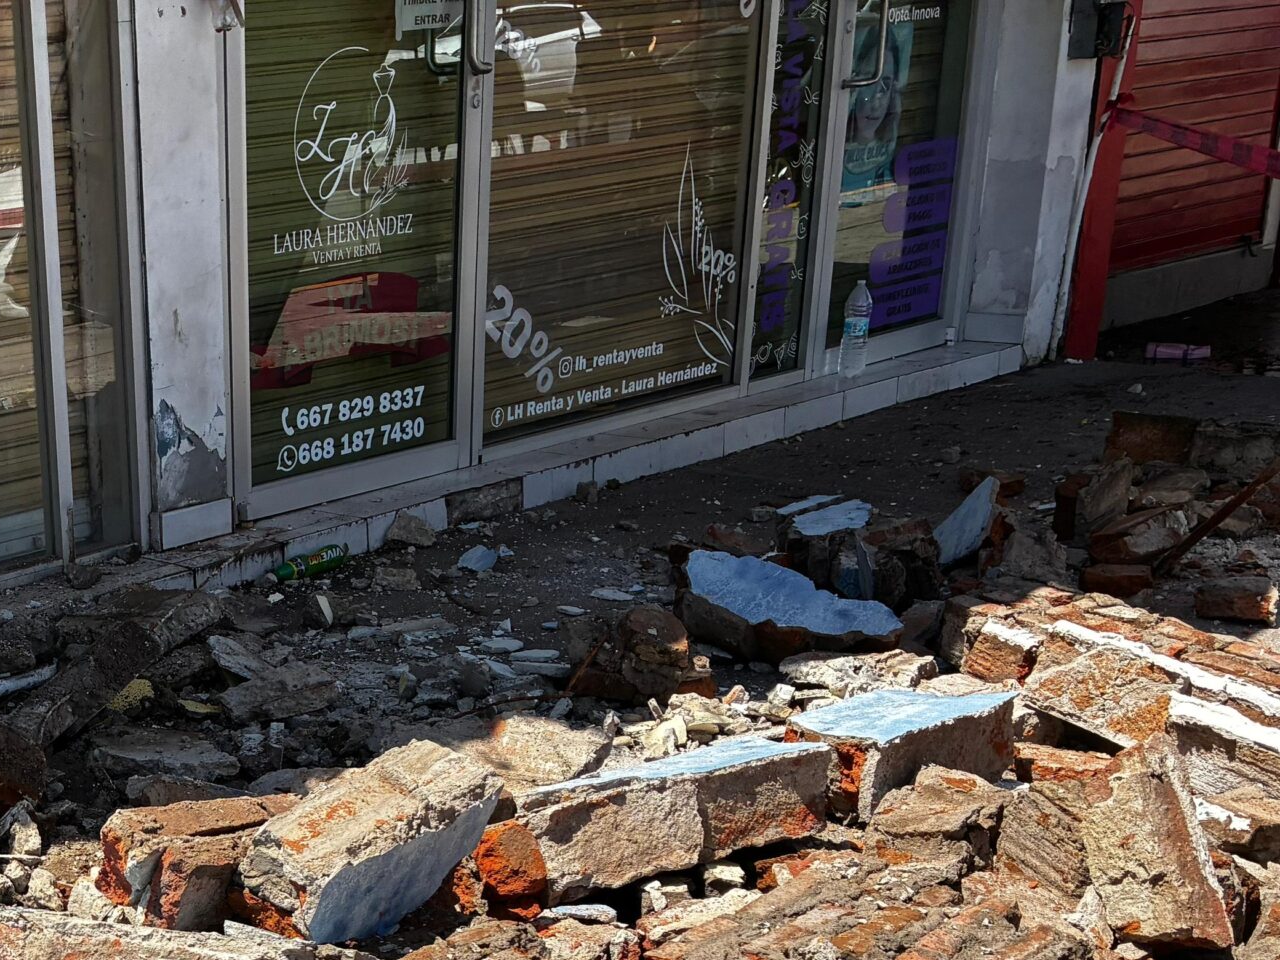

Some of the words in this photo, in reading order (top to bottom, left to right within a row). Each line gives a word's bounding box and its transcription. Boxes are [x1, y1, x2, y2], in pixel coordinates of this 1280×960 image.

[414, 13, 451, 25] ENTRAR
[912, 6, 940, 21] Innova
[274, 228, 323, 255] LAURA
[327, 214, 413, 246] HERNÁNDEZ
[313, 249, 345, 264] VENTA
[346, 247, 354, 256] Y
[354, 243, 382, 259] RENTA
[697, 245, 737, 284] 20%
[761, 179, 797, 333] GRATIS
[484, 285, 563, 393] 20%
[575, 341, 664, 373] lh_rentayventa
[296, 403, 333, 430] 667
[338, 396, 374, 421] 829
[379, 385, 425, 413] 8337
[507, 402, 524, 421] LH
[527, 396, 564, 418] Renta
[566, 396, 575, 410] y
[577, 386, 612, 405] Venta
[621, 376, 655, 395] Laura
[657, 363, 718, 387] Hernández
[298, 438, 334, 464] 668
[340, 428, 375, 455] 187
[381, 417, 425, 446] 7430
